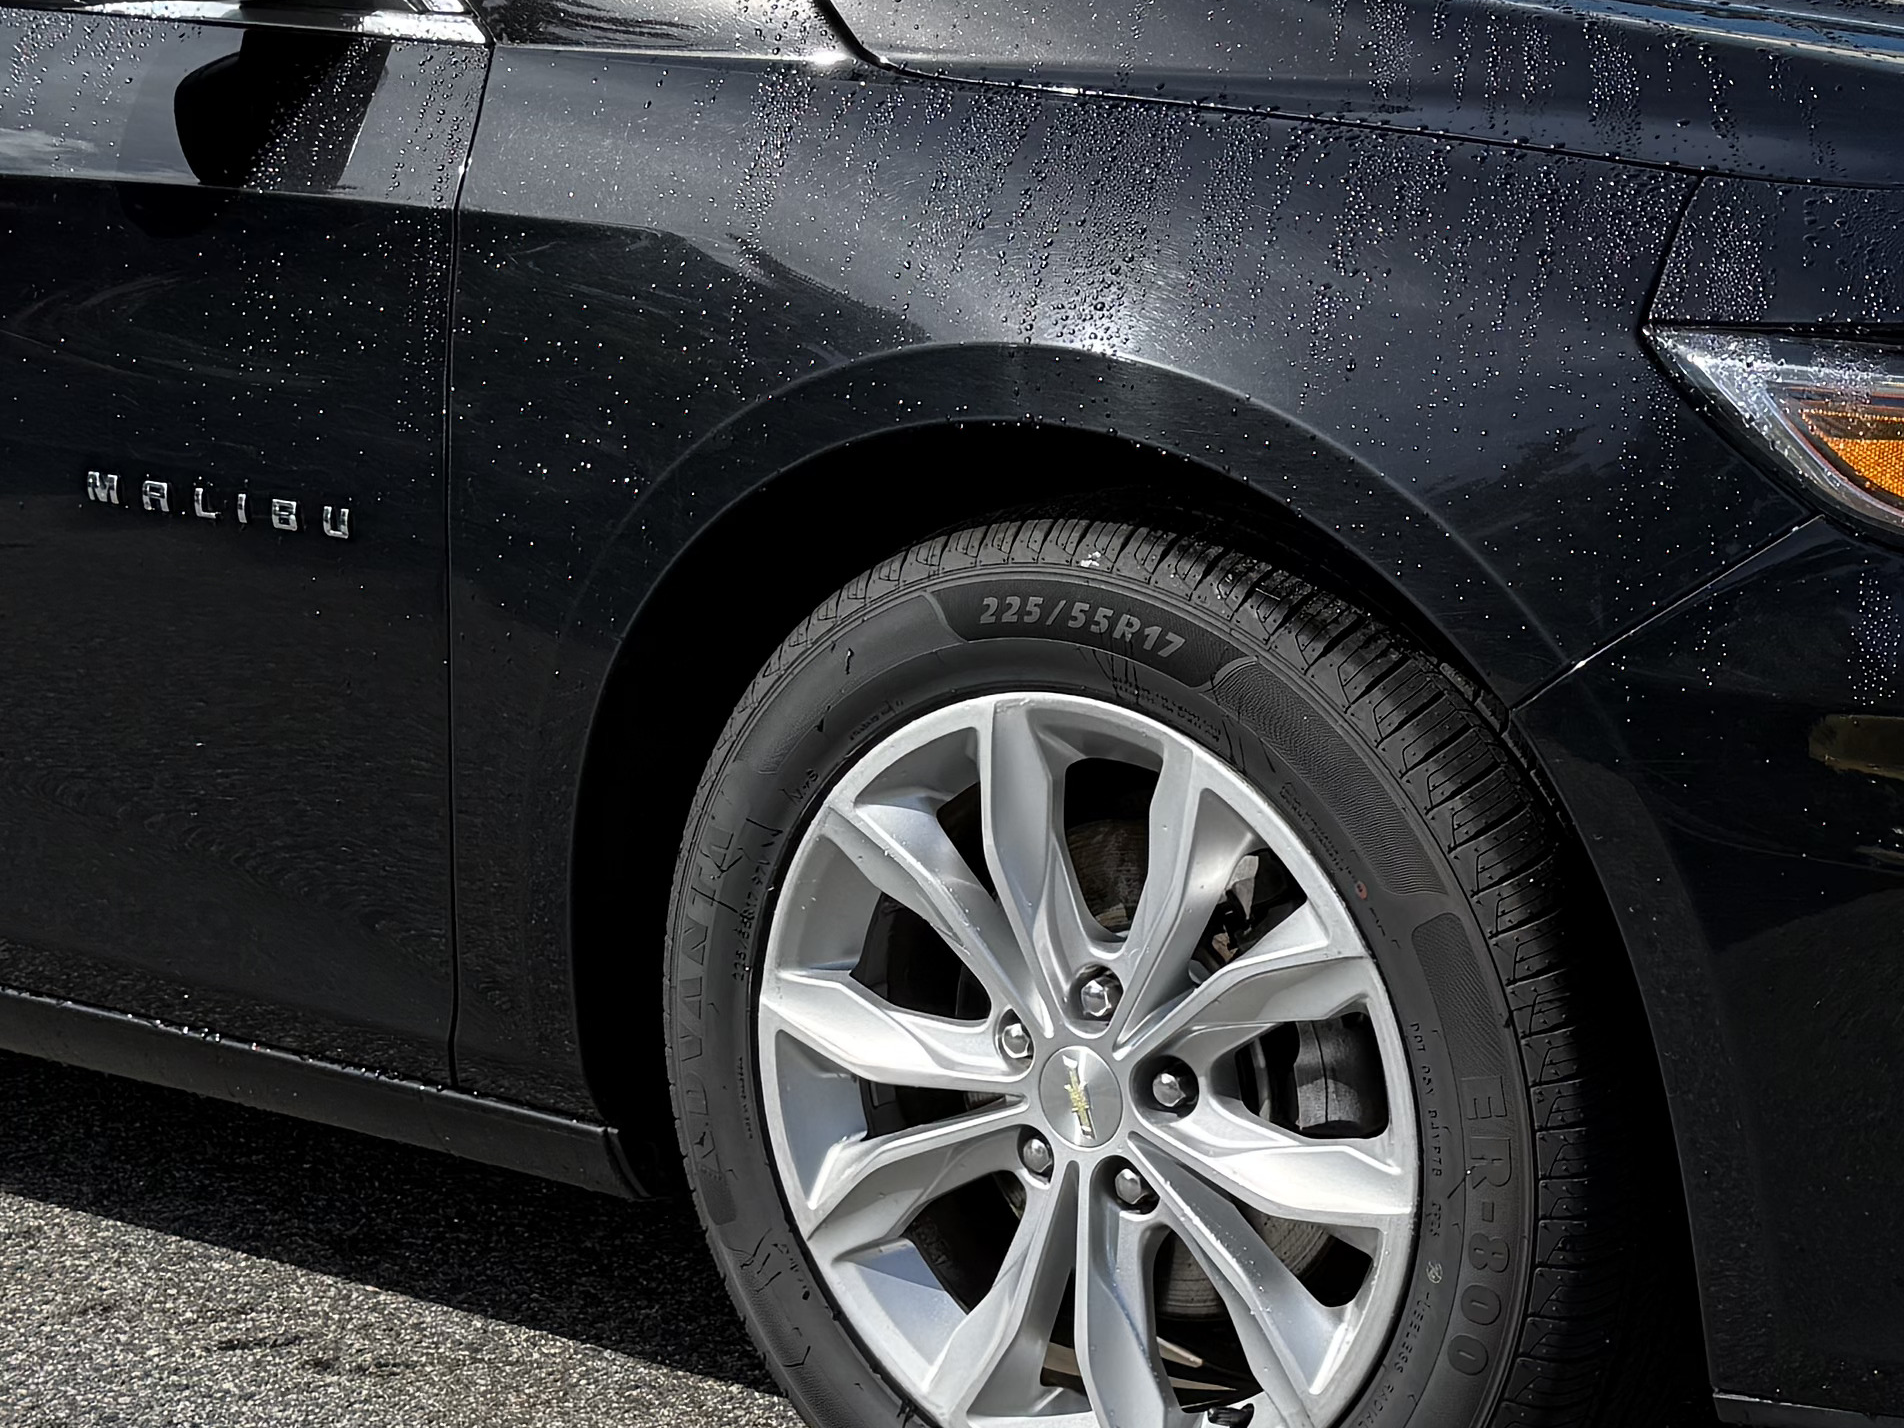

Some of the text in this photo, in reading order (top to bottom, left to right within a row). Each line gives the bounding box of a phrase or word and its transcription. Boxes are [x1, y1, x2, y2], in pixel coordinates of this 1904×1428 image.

[86, 470, 351, 540] MALIBU
[980, 595, 1186, 658] 225/55R17
[1447, 1075, 1513, 1376] ER-800
